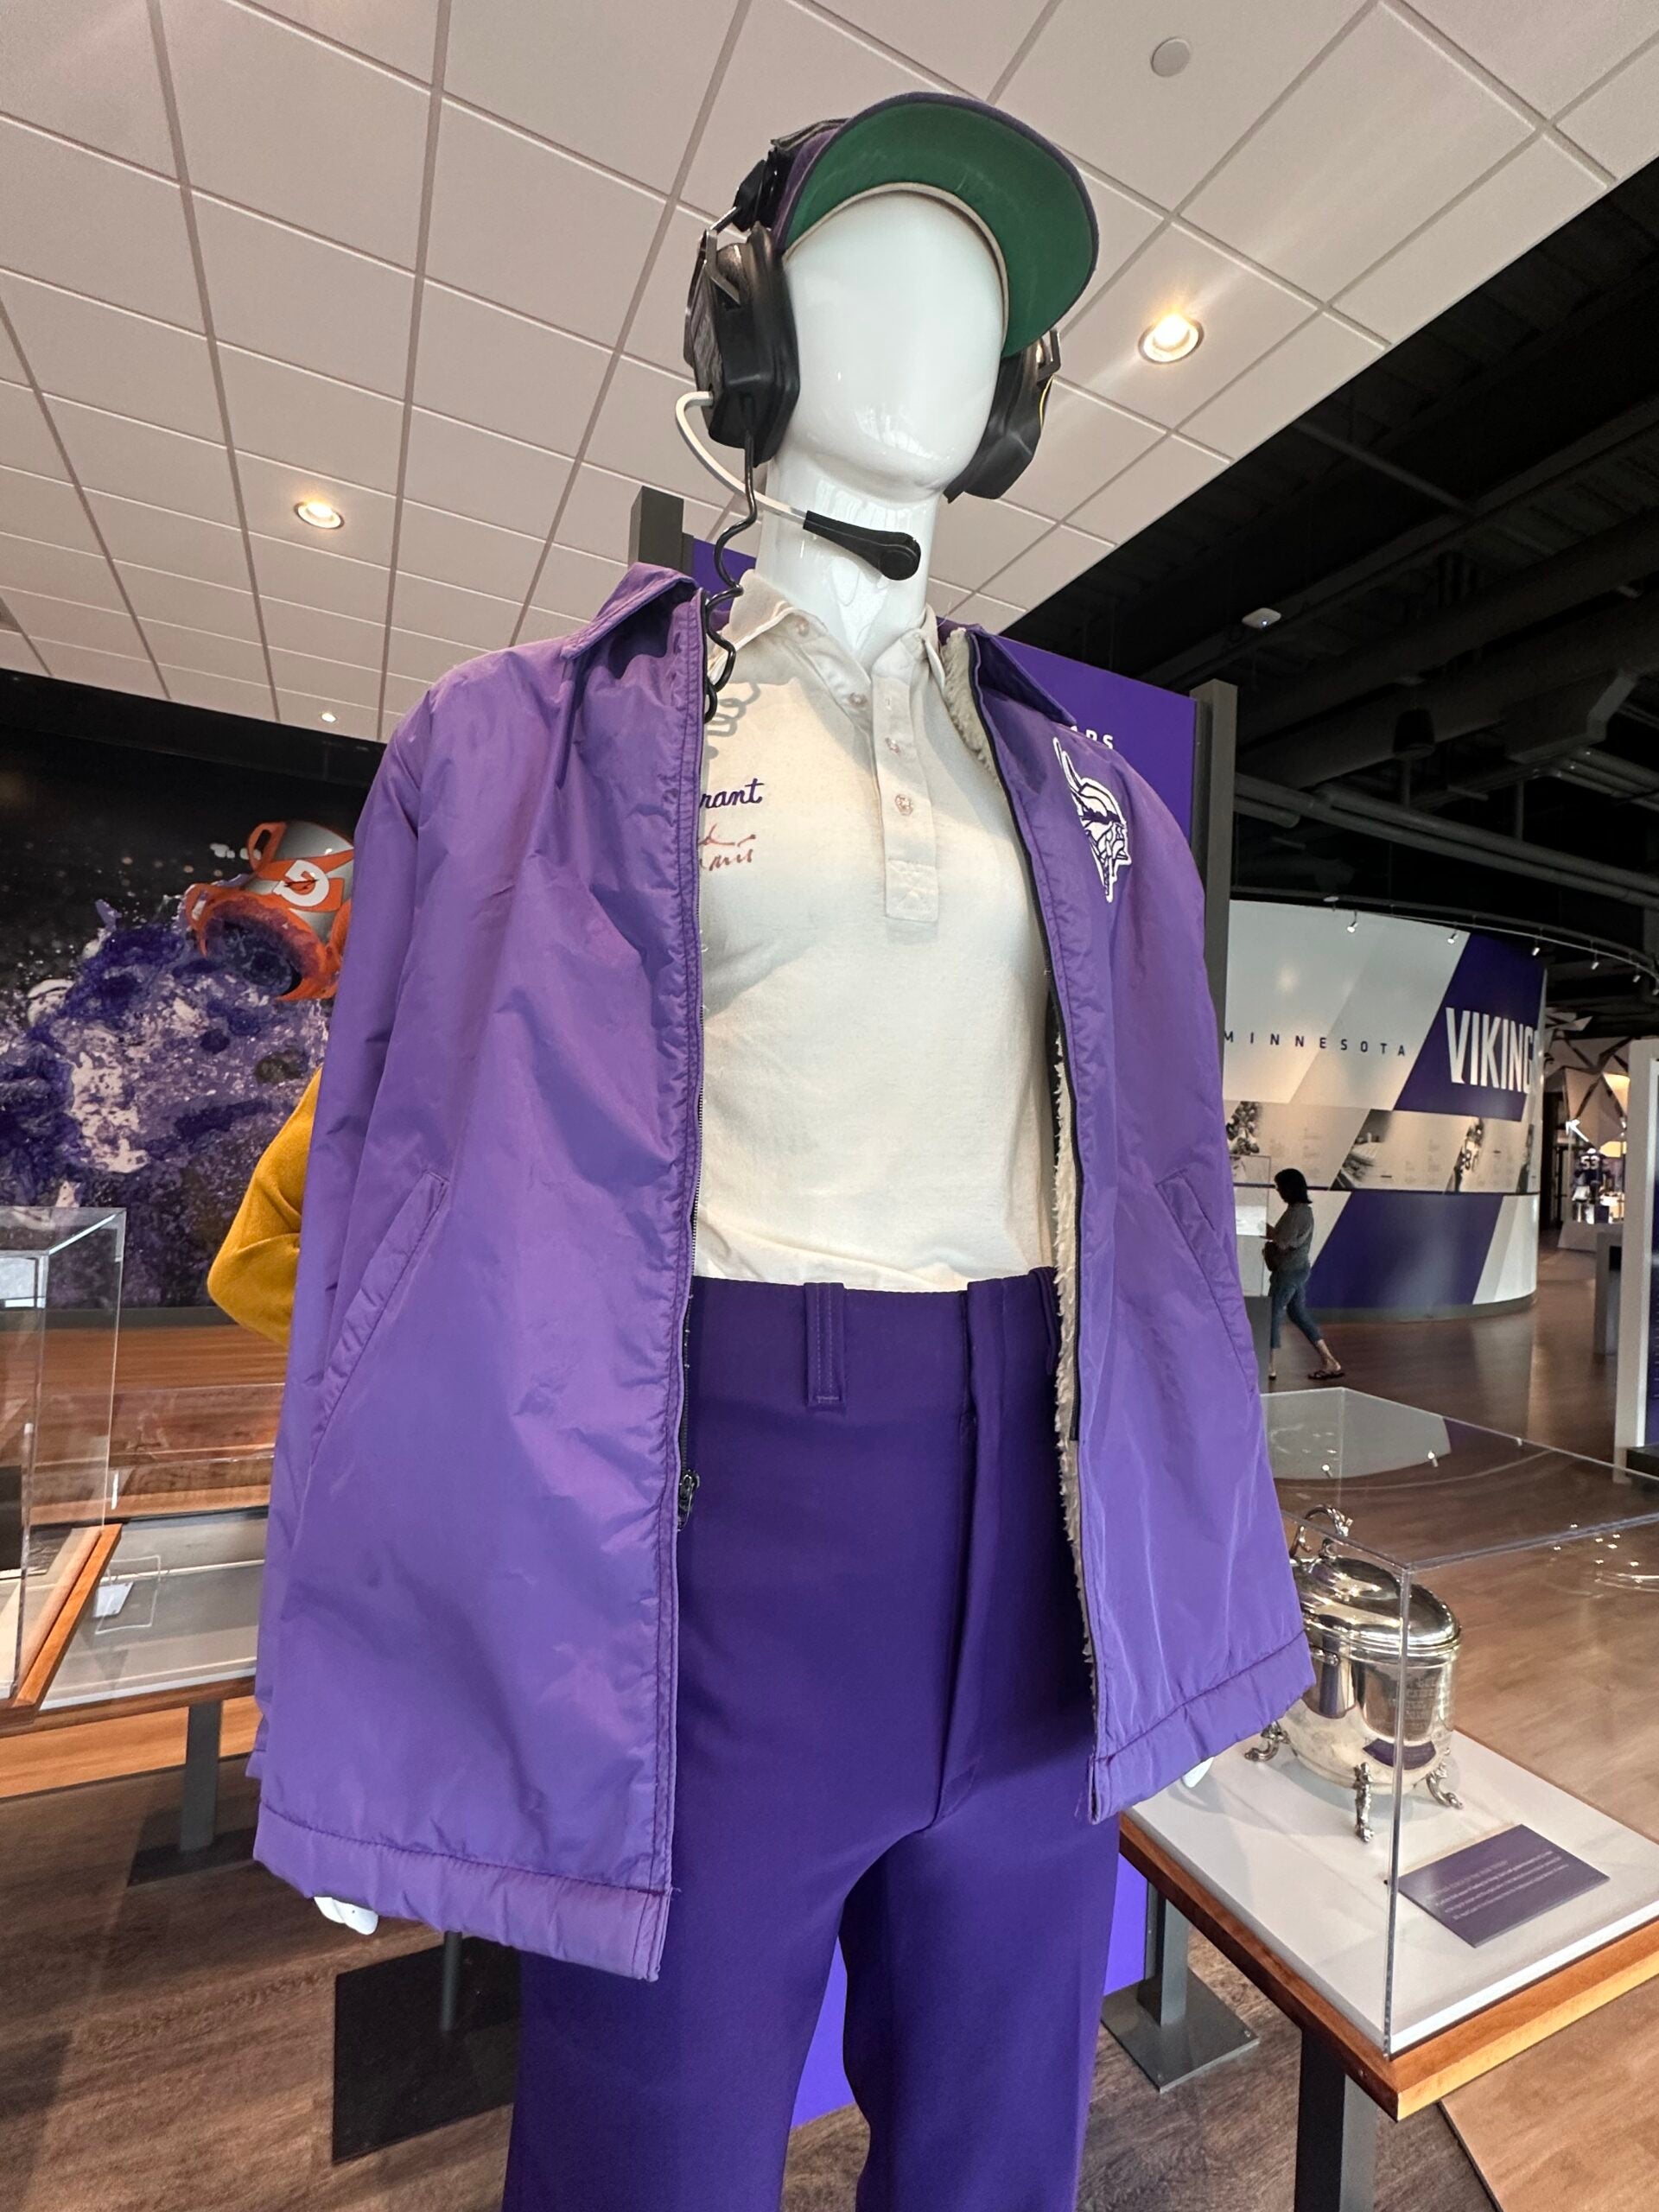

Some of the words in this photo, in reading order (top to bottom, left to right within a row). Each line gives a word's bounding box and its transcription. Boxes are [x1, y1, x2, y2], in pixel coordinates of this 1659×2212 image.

[699, 778, 765, 809] rant
[1224, 1031, 1405, 1056] MINNESOTA
[1446, 1007, 1539, 1094] VIKING
[1580, 1155, 1600, 1170] 53
